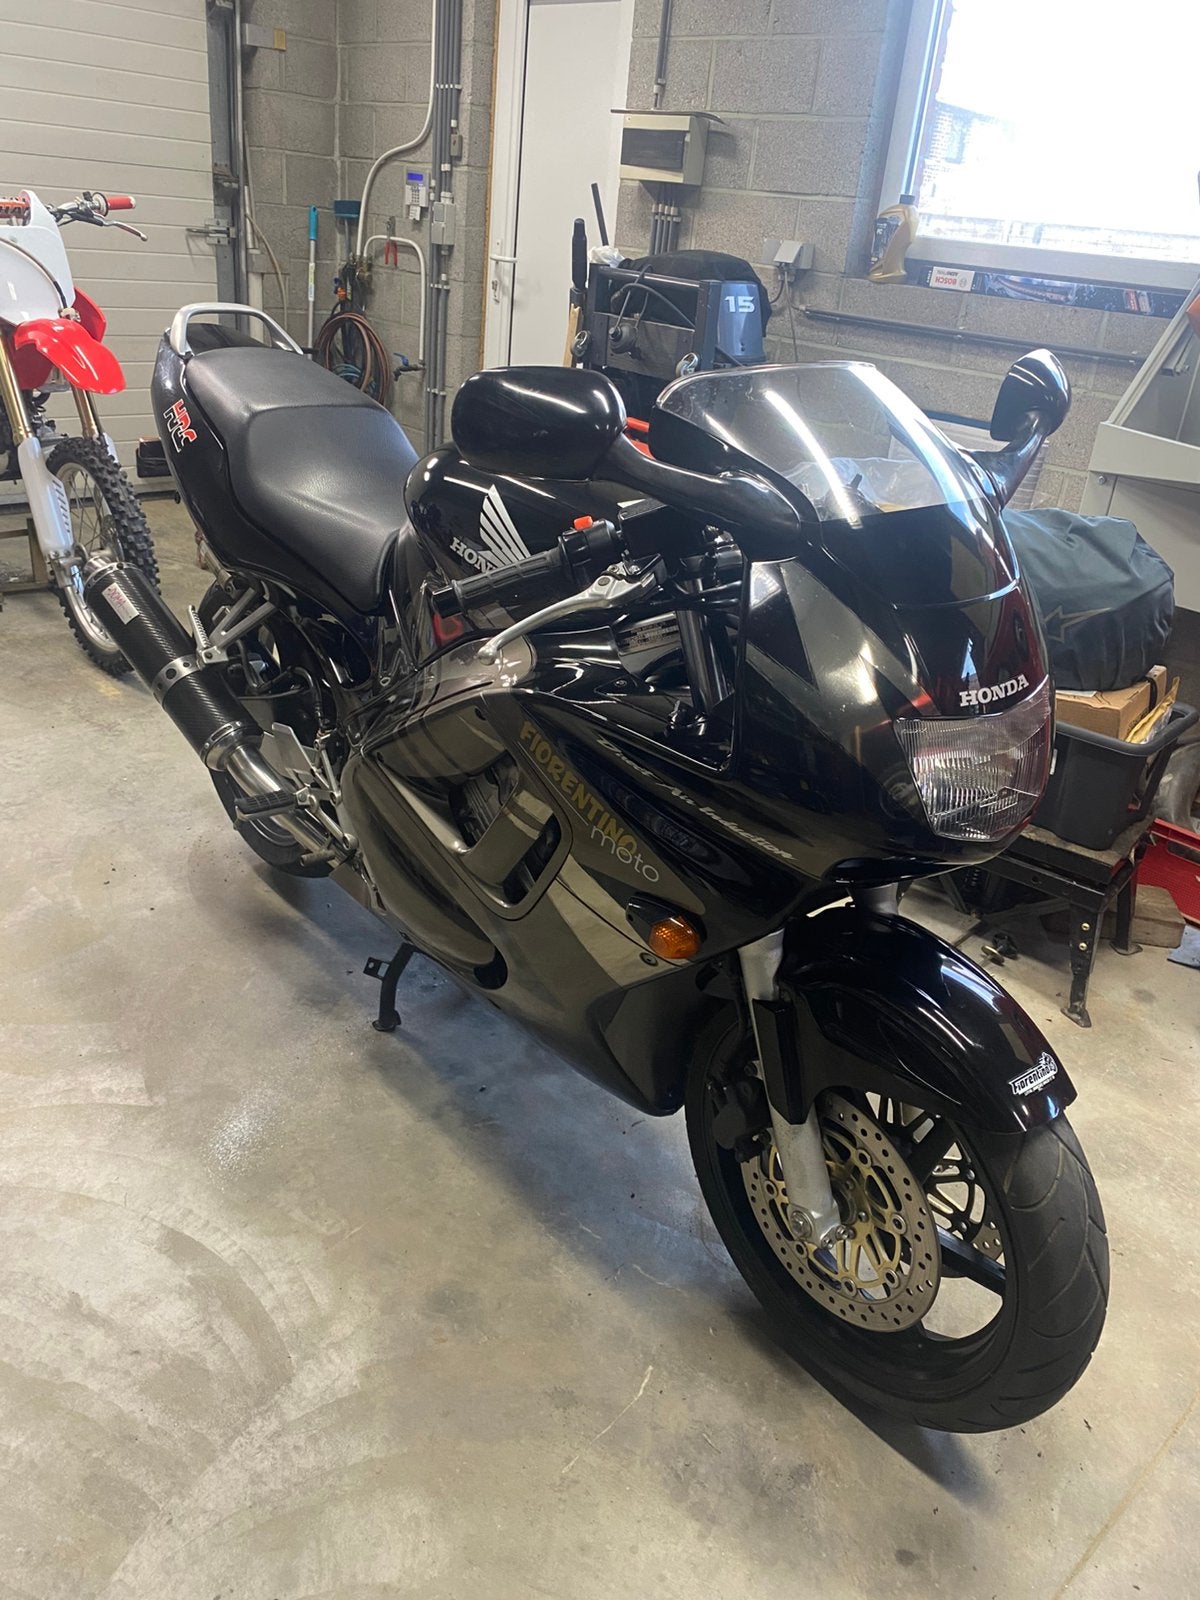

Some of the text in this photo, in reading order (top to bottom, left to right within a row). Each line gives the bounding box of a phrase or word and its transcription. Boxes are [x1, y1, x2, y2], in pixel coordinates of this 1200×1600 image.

[934, 275, 957, 286] BOSCH
[724, 295, 755, 313] 15
[163, 398, 198, 453] HRC
[449, 536, 499, 574] HON
[959, 674, 1029, 707] HONDA
[519, 720, 638, 856] FIORENTINO
[597, 736, 662, 783] Direct
[698, 806, 799, 861] Induction
[590, 825, 660, 883] moto
[1011, 1065, 1051, 1094] Fiorentino
